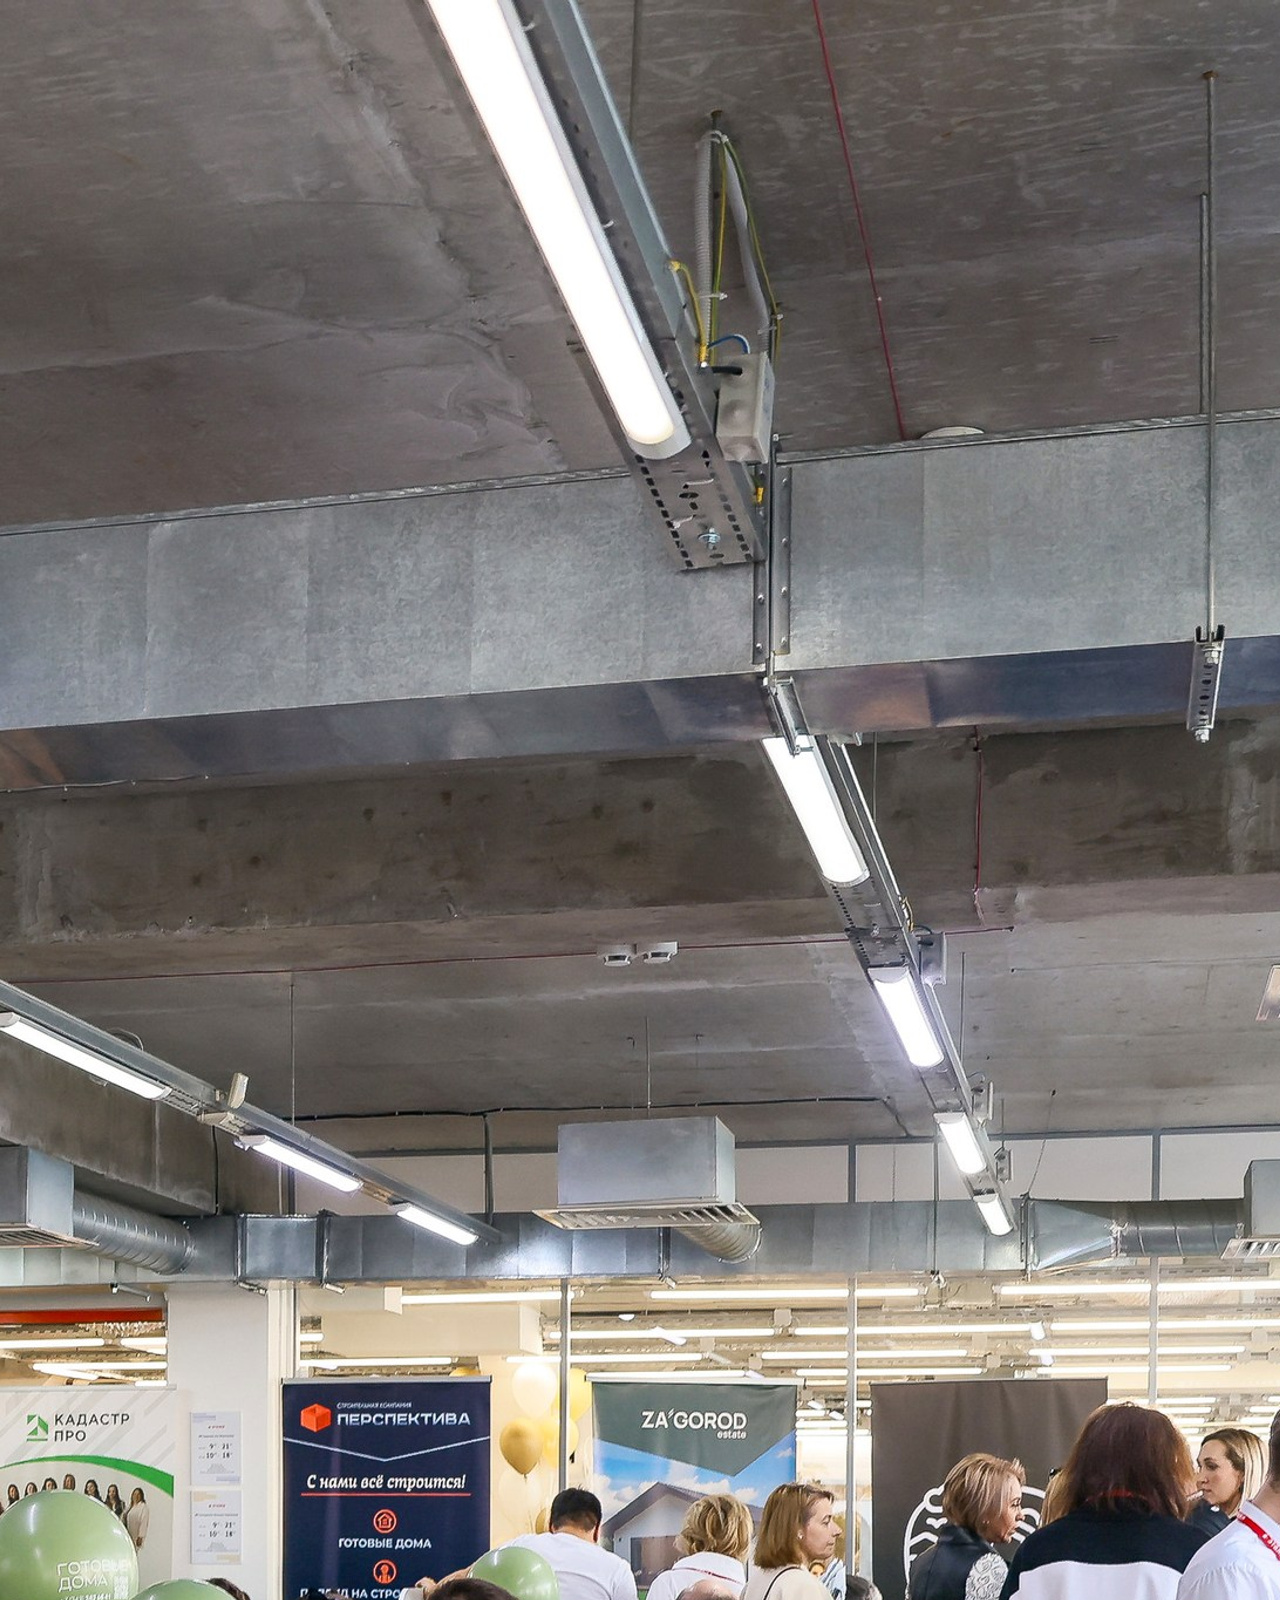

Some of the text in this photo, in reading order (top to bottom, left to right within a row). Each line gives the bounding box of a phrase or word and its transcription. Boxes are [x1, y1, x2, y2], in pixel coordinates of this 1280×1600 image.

[54, 1413, 130, 1427] КАДАСТР
[337, 1412, 471, 1426] ПЕРСПЕКТИВА
[54, 1429, 87, 1442] ПРО
[716, 1430, 748, 1439] estate
[307, 1474, 467, 1492] С нами всё строится!
[338, 1537, 432, 1550] ГОТОВЫЕ ДОМА
[56, 1559, 128, 1576] ГОТОВЫЕ
[58, 1574, 108, 1593] ДОМА
[351, 1588, 368, 1599] НА
